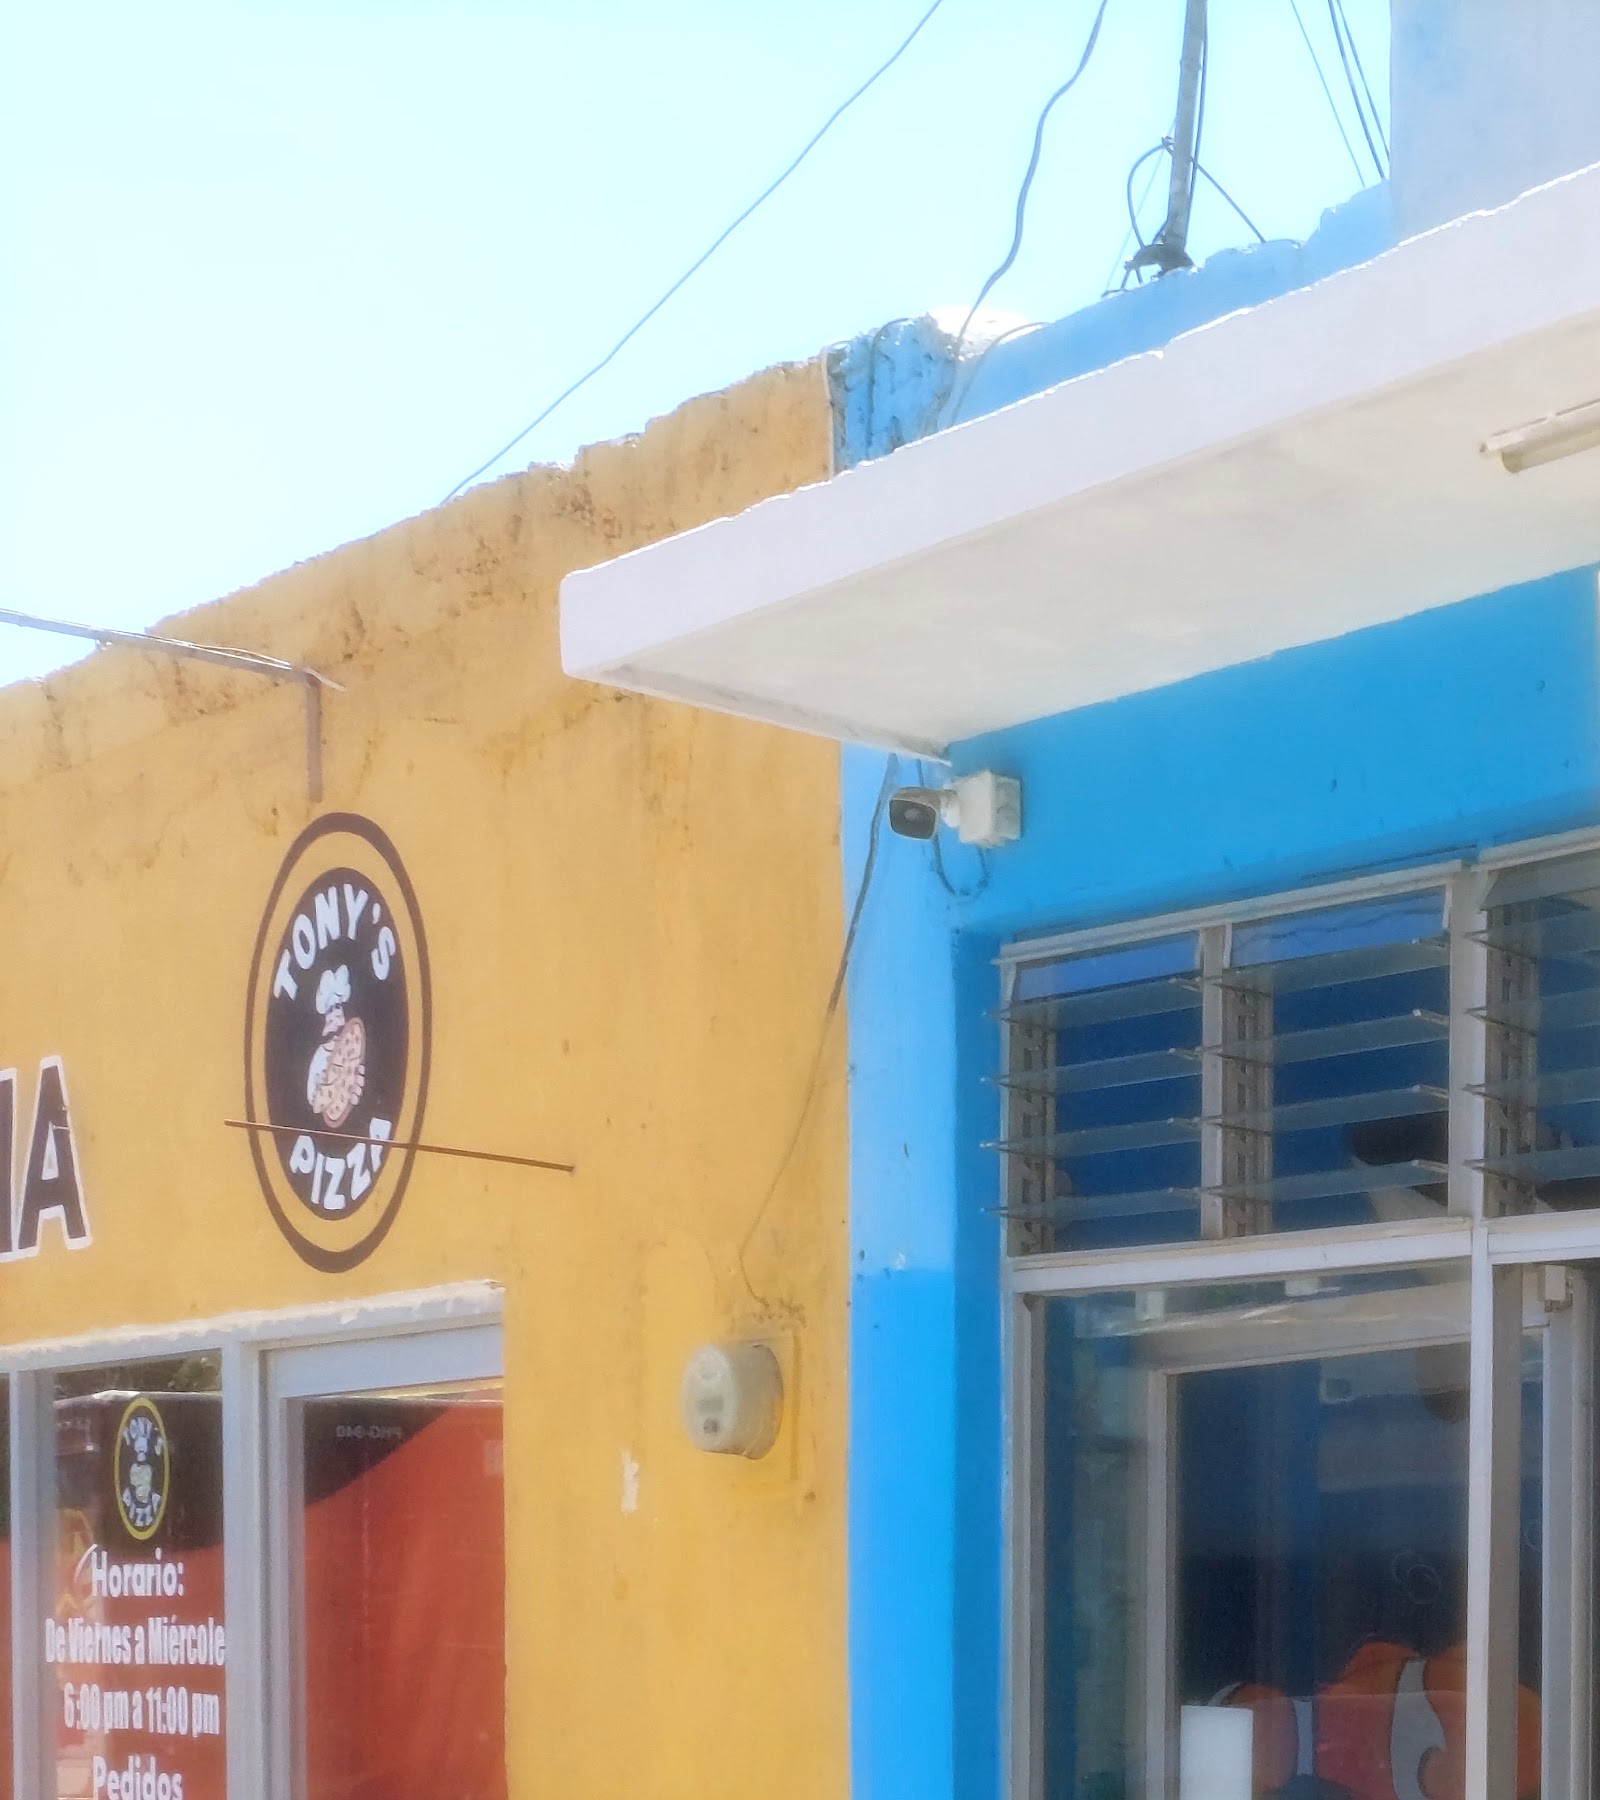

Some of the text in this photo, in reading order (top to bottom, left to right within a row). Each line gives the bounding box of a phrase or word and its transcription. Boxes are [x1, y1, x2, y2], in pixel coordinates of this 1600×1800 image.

[273, 883, 395, 1001] TONY'S
[91, 1547, 184, 1597] Horario:
[45, 1615, 226, 1666] De Viernes a Miércole
[64, 1682, 220, 1738] 6:00 pm a 11:00 pm
